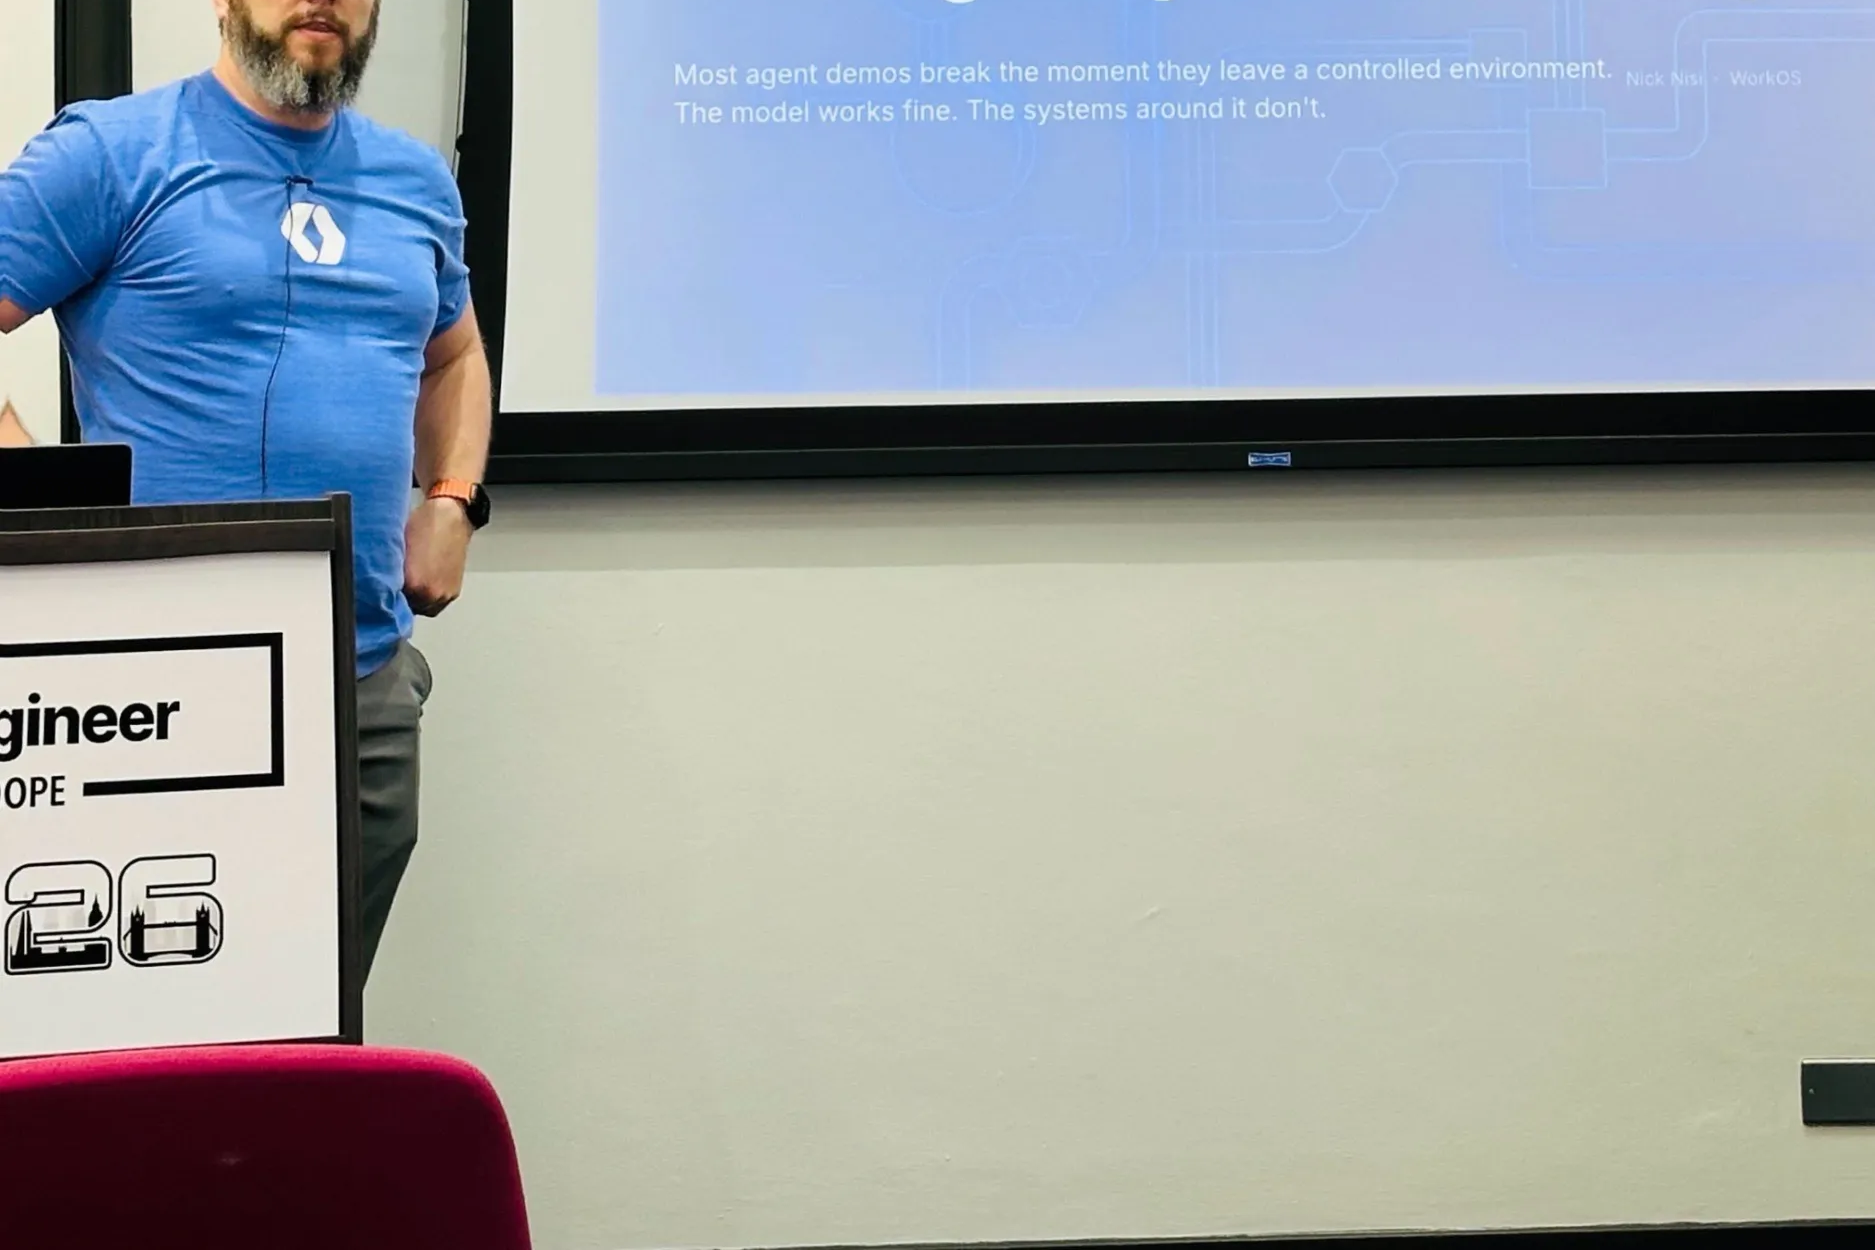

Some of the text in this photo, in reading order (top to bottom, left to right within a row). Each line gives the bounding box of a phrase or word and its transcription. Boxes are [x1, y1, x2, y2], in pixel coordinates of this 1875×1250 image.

[674, 57, 1612, 91] Most agent demos break the moment they leave a controlled environment.
[1626, 69, 1665, 86] Nick
[1730, 69, 1802, 86] WorkOS
[674, 97, 1326, 126] The model works fine. The systems around it don't.
[0, 692, 180, 762] gineer
[0, 775, 66, 809] OPE
[4, 853, 224, 975] 26
